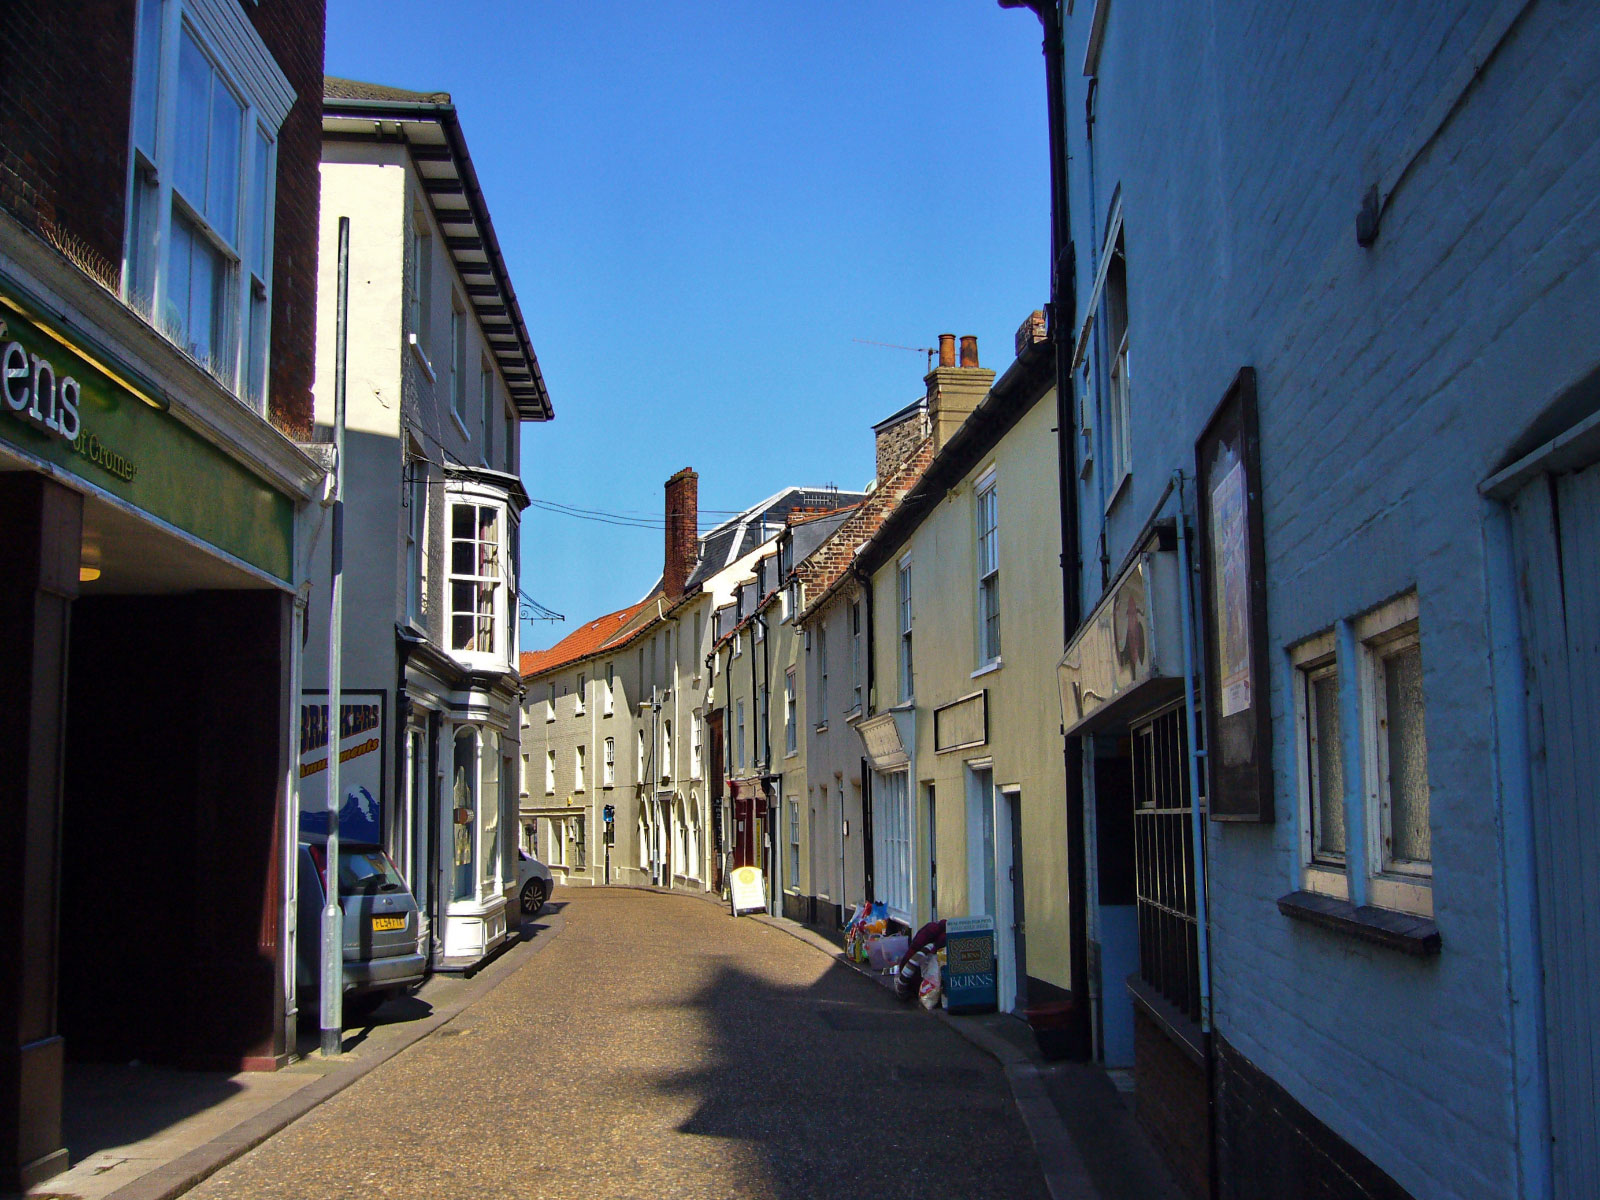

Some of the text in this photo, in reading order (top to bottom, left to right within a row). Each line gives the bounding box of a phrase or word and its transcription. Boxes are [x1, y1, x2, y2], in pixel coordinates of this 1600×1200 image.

[73, 429, 138, 481] of Cromer
[301, 705, 379, 755] BREKERS
[950, 974, 993, 988] BURNS
